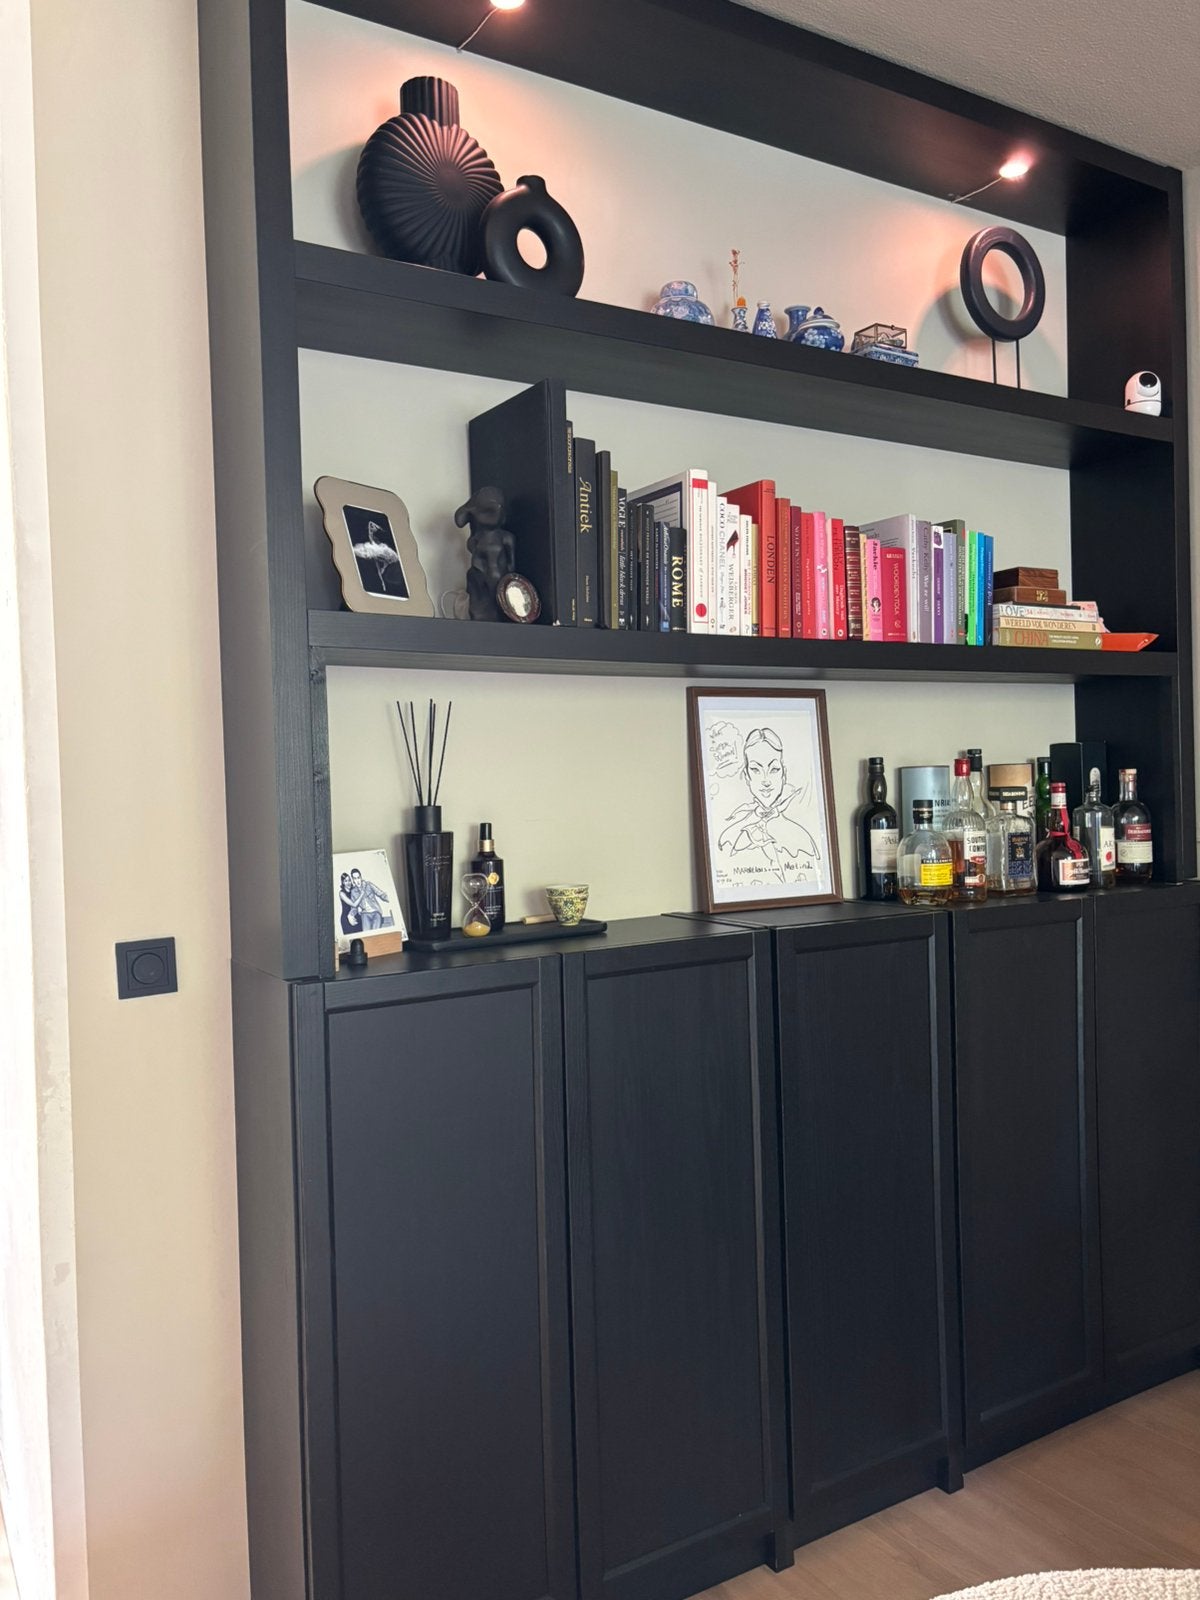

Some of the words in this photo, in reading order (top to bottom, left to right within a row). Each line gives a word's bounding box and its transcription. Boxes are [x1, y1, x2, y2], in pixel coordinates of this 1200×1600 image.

[579, 477, 592, 535] Antiek
[618, 496, 626, 528] VOGUE
[766, 535, 775, 585] LONDEN
[671, 555, 684, 608] ROME
[1004, 618, 1031, 628] WERELD
[1033, 620, 1043, 629] VOL
[1044, 621, 1077, 630] WONDEREN
[1014, 630, 1049, 646] CHINA
